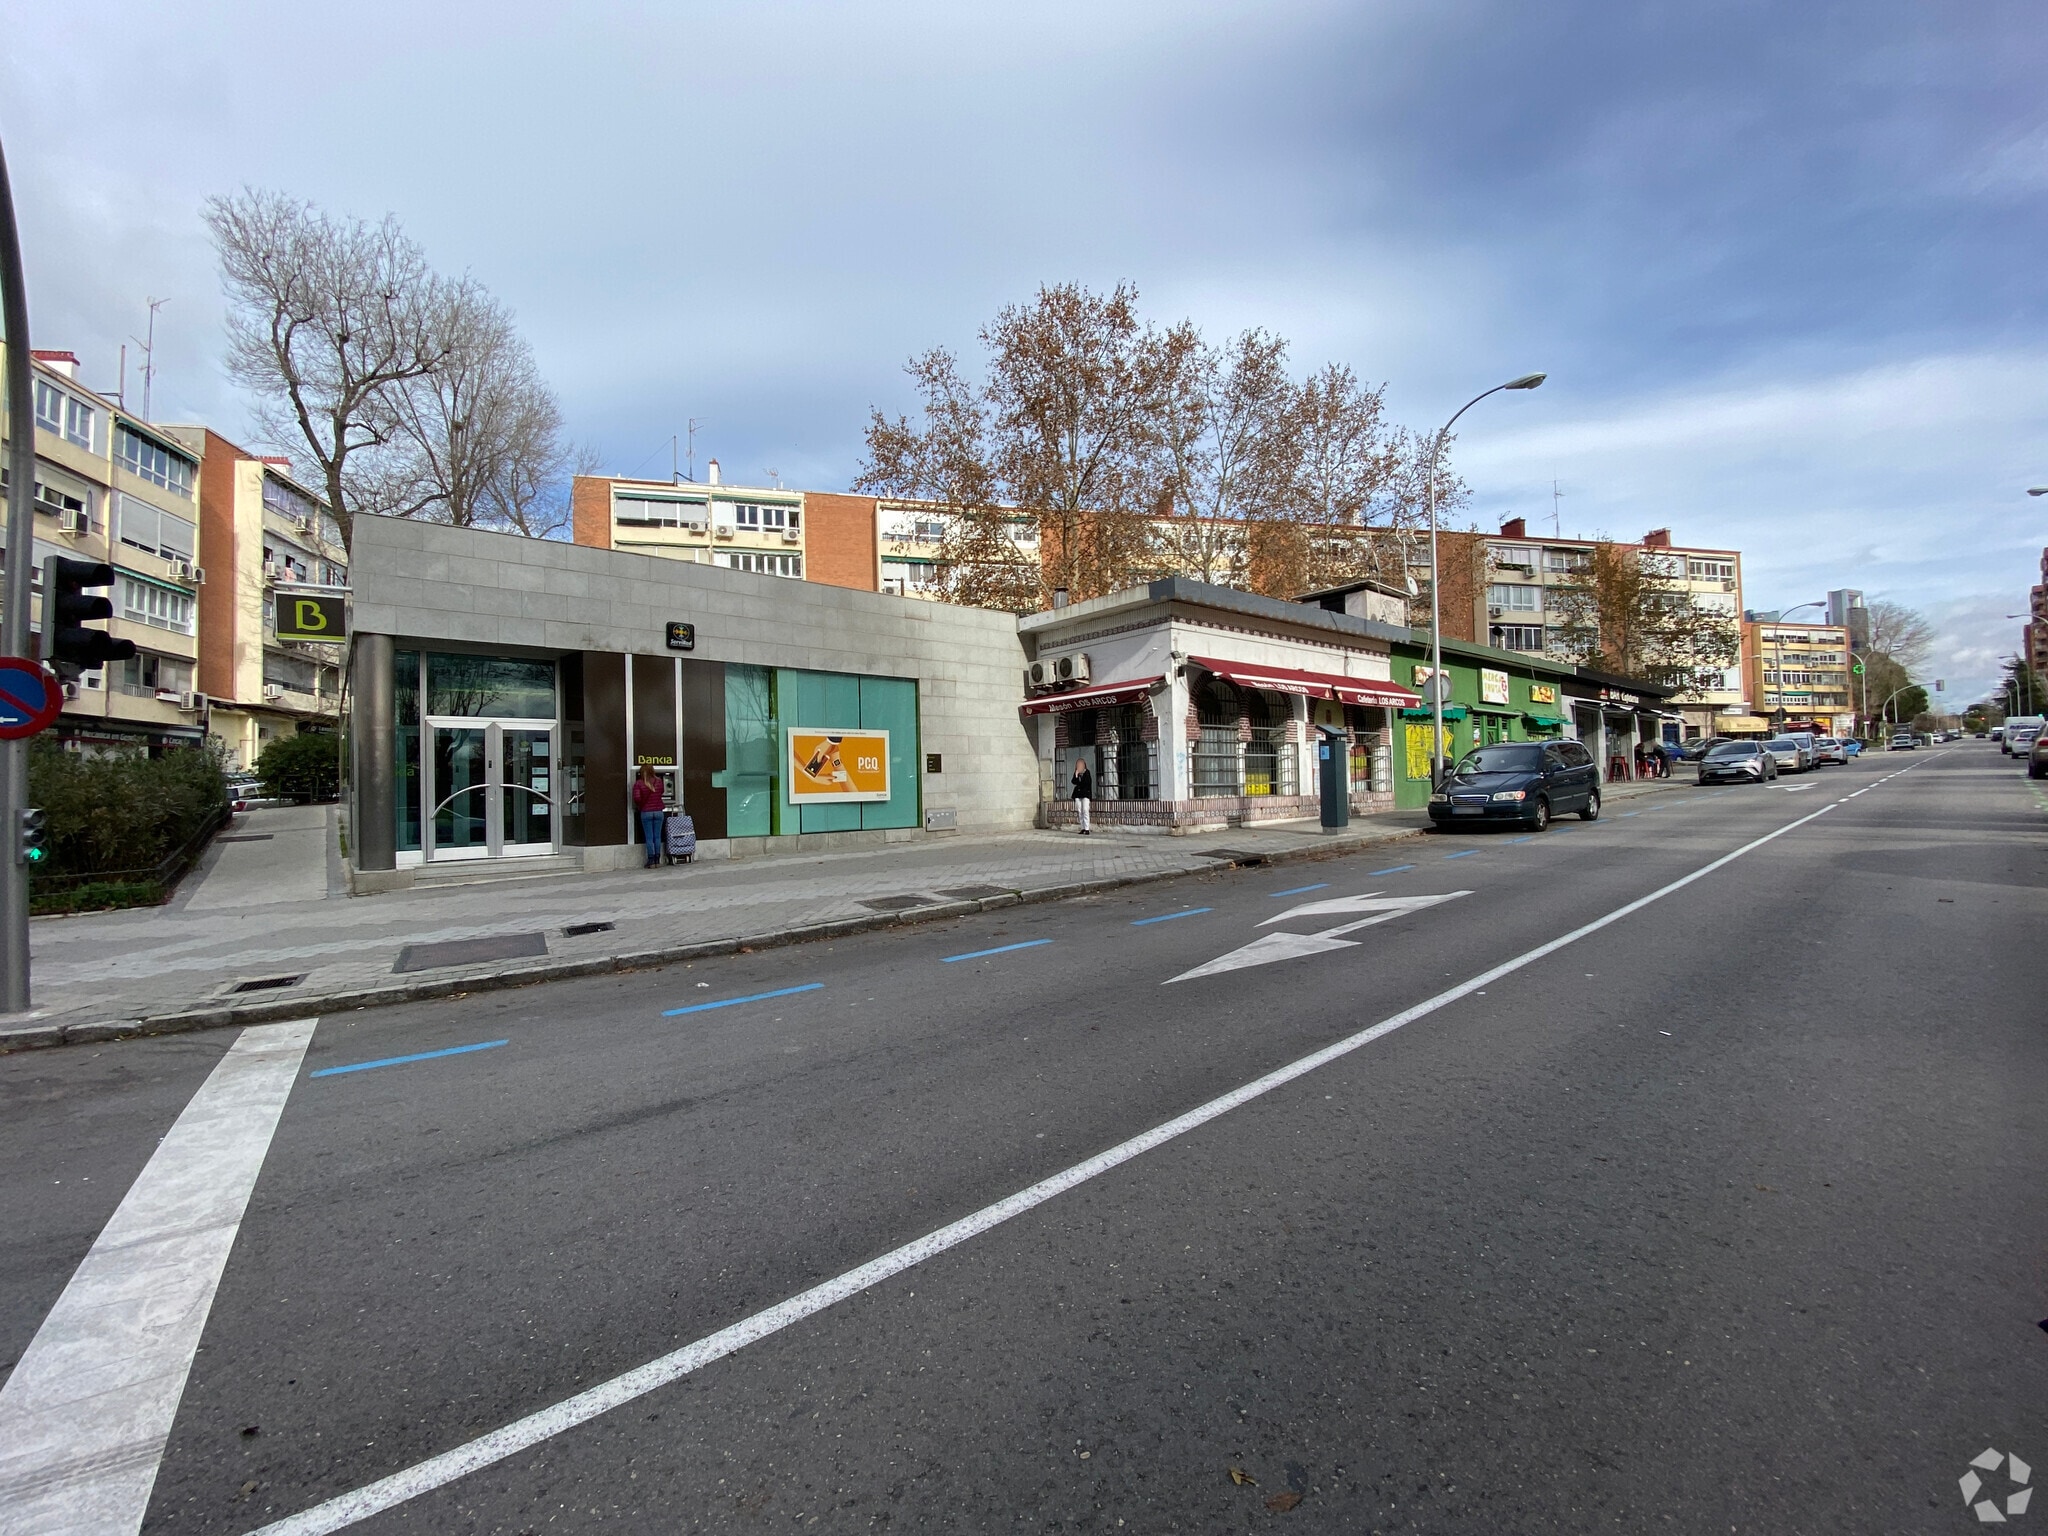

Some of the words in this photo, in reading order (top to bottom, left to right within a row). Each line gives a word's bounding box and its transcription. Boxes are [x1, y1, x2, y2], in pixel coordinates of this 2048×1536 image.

[295, 600, 328, 631] B
[1048, 702, 1073, 712] Mesón
[1073, 700, 1091, 708] LOS
[1091, 695, 1118, 706] ARCOS
[1378, 697, 1389, 705] LOS
[1389, 698, 1406, 706] ARCOS
[637, 755, 673, 764] Bankia
